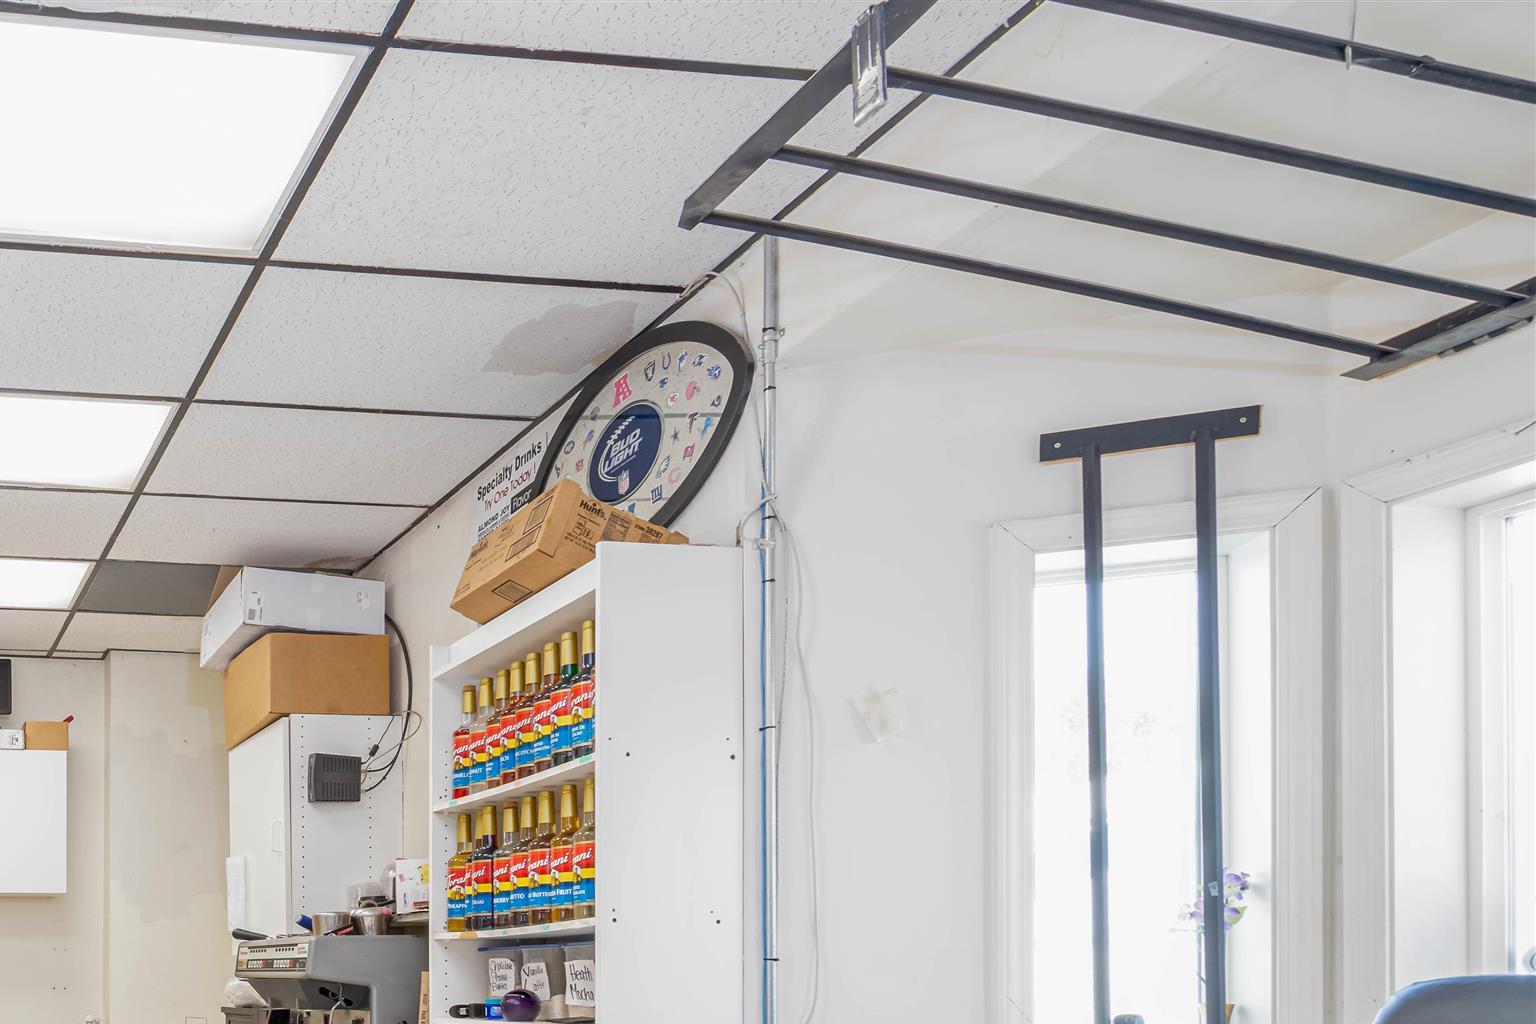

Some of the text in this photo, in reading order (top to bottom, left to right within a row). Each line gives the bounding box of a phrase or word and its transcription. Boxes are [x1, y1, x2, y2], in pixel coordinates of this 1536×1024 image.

[603, 437, 643, 474] LIGHT
[609, 428, 641, 459] BUD
[477, 464, 513, 501] Specialty
[514, 441, 542, 471] Drinks
[484, 499, 493, 512] Try
[494, 486, 509, 504] One
[510, 467, 532, 491] Today
[477, 512, 499, 533] ALMOND
[499, 504, 510, 517] JOY
